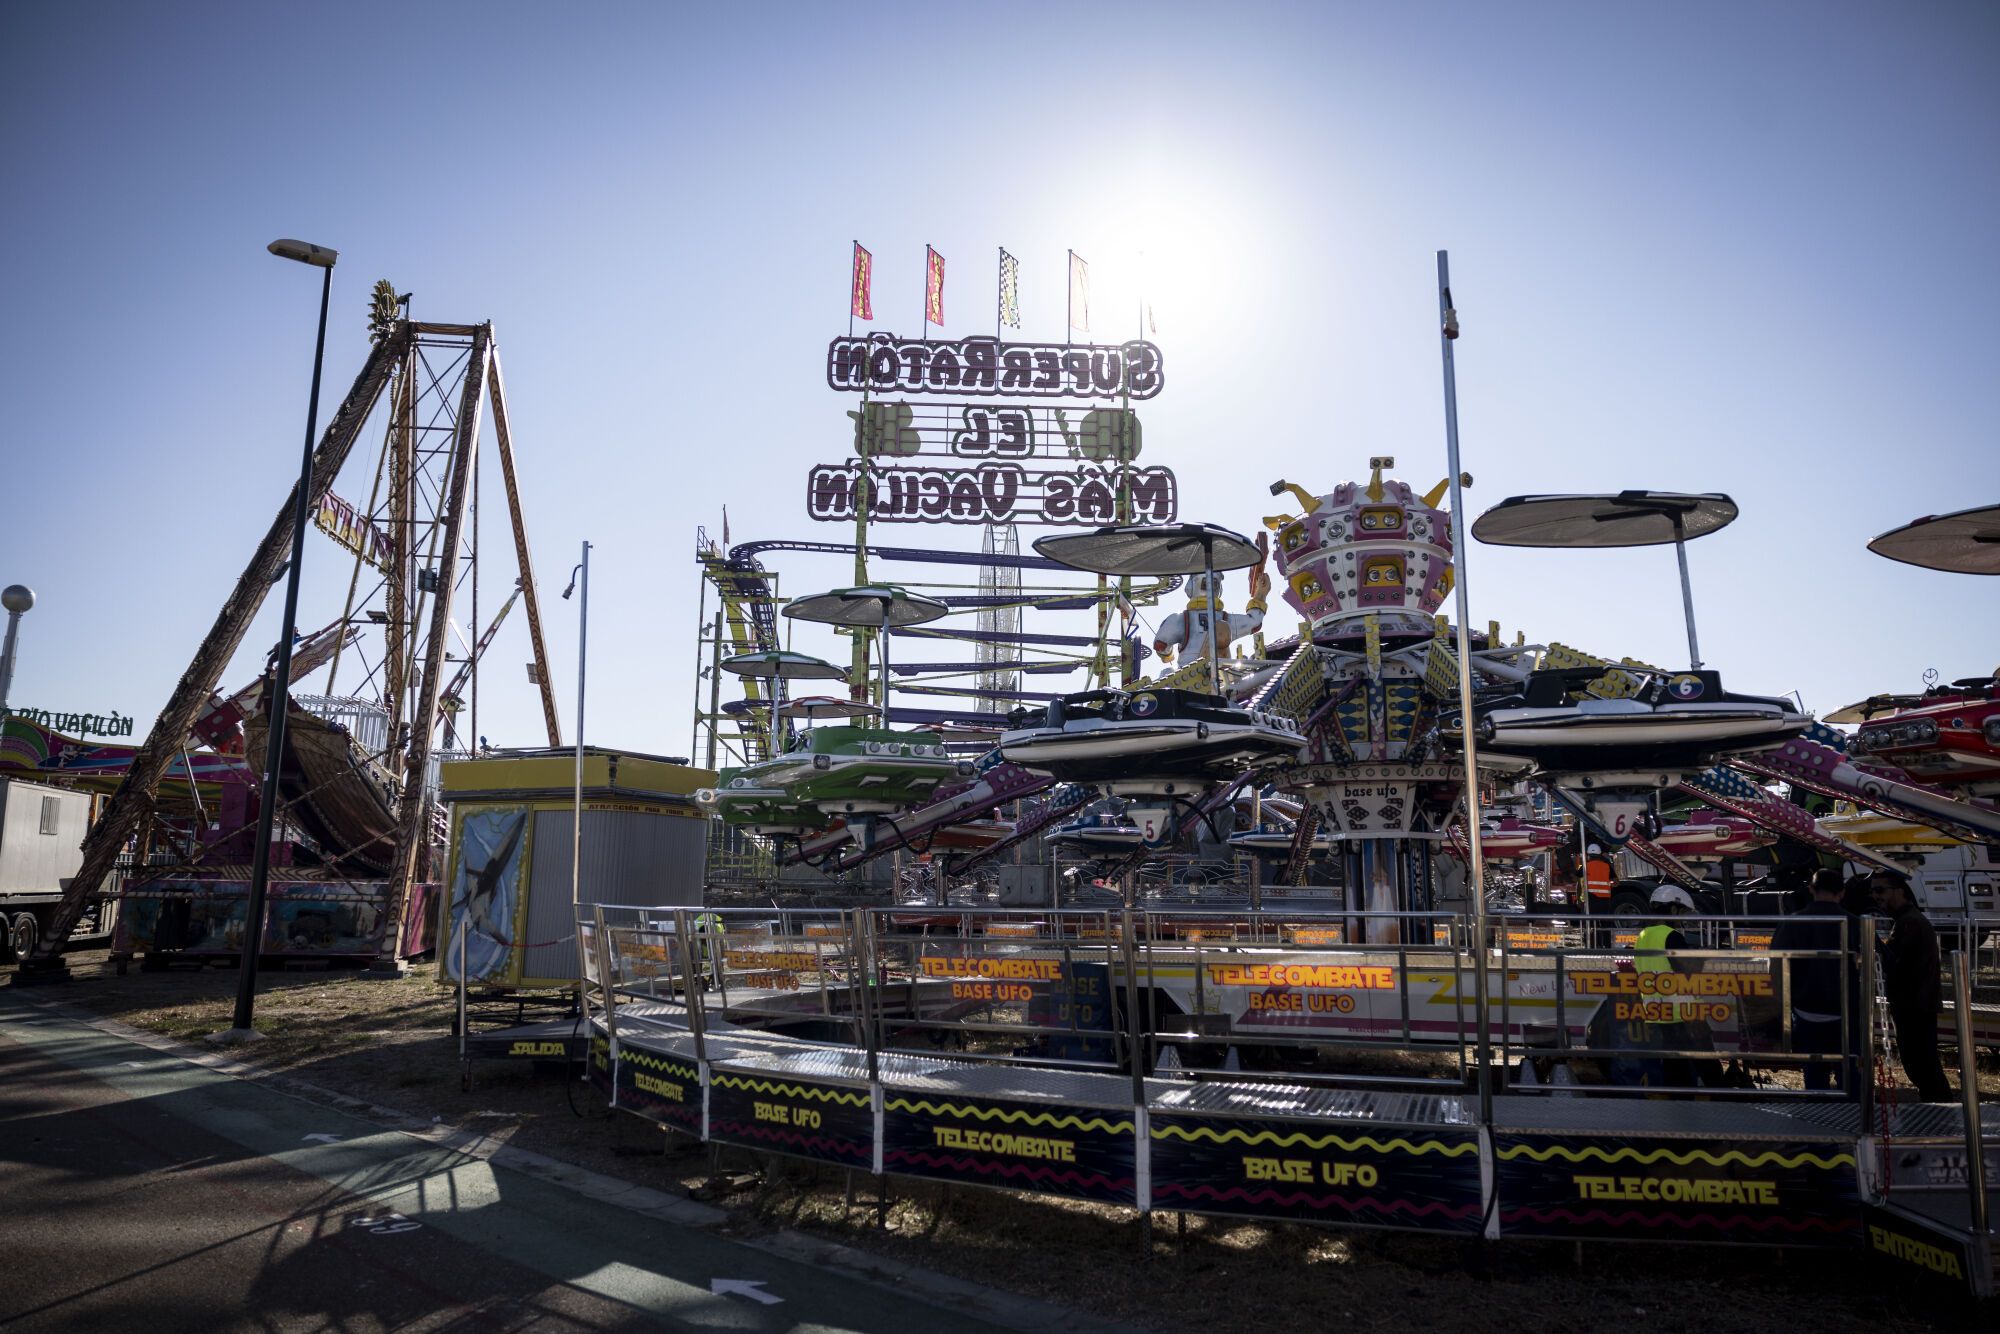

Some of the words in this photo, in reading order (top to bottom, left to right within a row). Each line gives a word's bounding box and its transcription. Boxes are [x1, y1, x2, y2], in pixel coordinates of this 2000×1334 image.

[1679, 677, 1694, 696] 6
[1138, 699, 1150, 711] 5
[1345, 785, 1372, 797] base
[1377, 783, 1397, 798] ufo
[1145, 819, 1155, 840] 5
[1615, 813, 1626, 835] 6
[722, 950, 818, 972] TELECOMBATE
[920, 956, 1063, 980] TELECOMBATE
[746, 973, 773, 989] BASE
[775, 975, 800, 991] UFO
[1207, 963, 1395, 989] TELECOMBATE
[1569, 971, 1773, 996] TELECOMBATE
[952, 983, 993, 1000] BASE
[996, 985, 1033, 1001] UFO
[1249, 992, 1304, 1012] BASE
[1308, 994, 1355, 1013] UFO
[1615, 1001, 1673, 1021] BASE
[1680, 1002, 1730, 1022] UFO
[508, 1041, 566, 1056] SALIDA
[634, 1071, 684, 1103] TELECOMBATE
[752, 1101, 791, 1126] BASE
[792, 1105, 822, 1130] UFO
[932, 1125, 1077, 1163] TELECOMBATE
[1242, 1155, 1316, 1184] BASE
[1321, 1161, 1379, 1188] UFO
[1572, 1174, 1781, 1206] TELECOMBATE
[1868, 1223, 1965, 1280] ENTRADA
